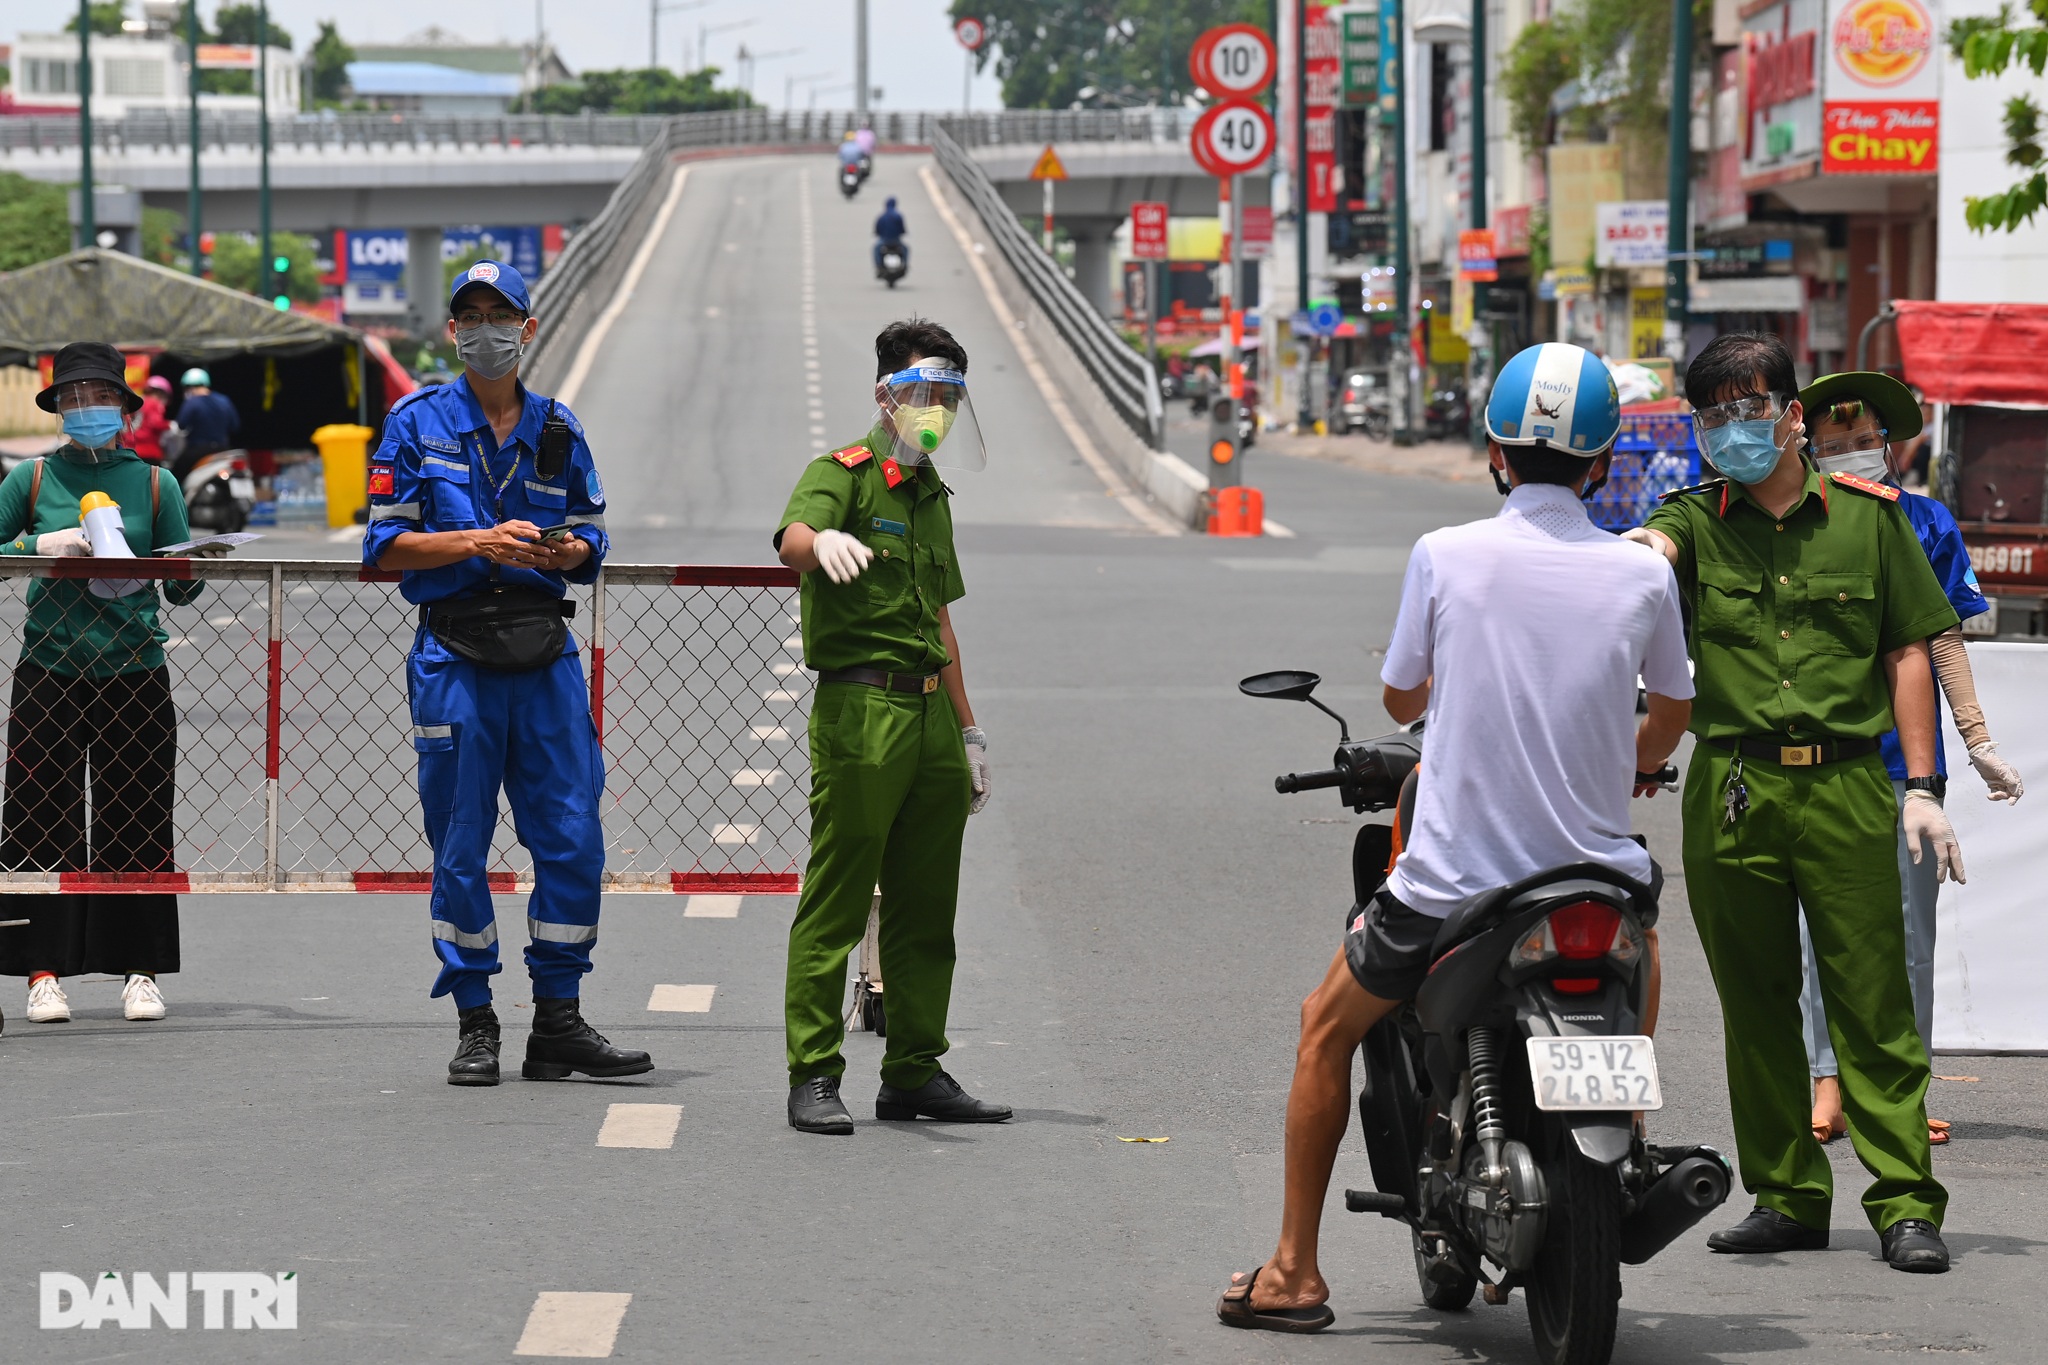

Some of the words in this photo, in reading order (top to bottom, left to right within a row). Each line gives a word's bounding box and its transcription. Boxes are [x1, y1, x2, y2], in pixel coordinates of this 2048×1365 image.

[1221, 119, 1255, 150] 40
[1829, 133, 1932, 166] Chay
[1535, 381, 1573, 395] Mosfly
